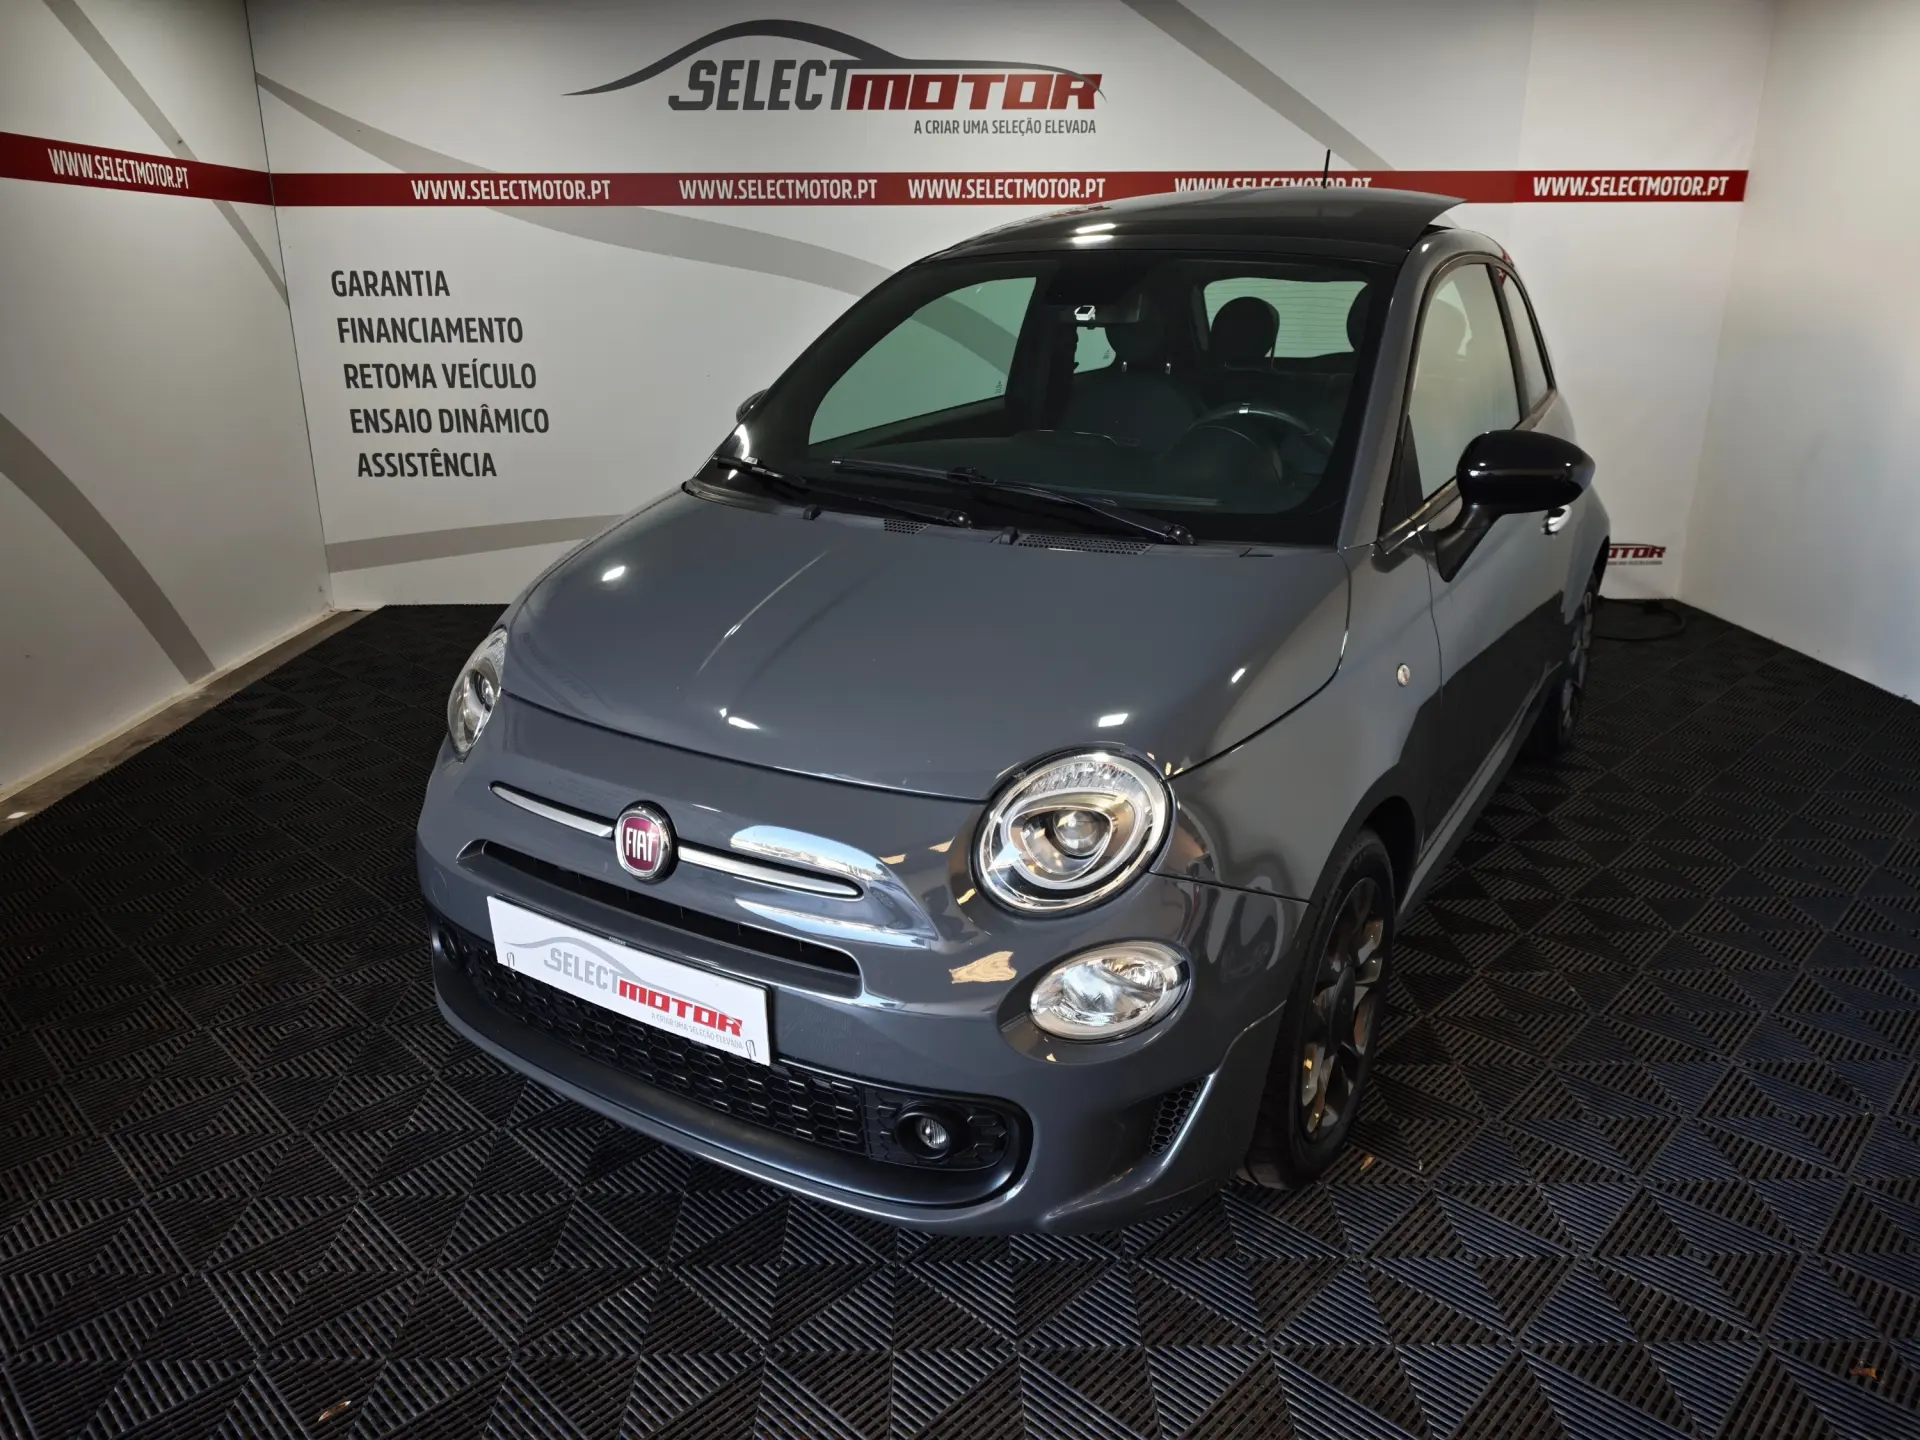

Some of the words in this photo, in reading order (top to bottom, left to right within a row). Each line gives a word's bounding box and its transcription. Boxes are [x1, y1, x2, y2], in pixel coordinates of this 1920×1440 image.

[914, 120, 922, 134] A
[925, 120, 960, 134] CRIAR
[963, 120, 989, 134] UMA
[992, 117, 1042, 136] SELEÇÃO
[1045, 119, 1096, 134] ELEVADA
[47, 148, 189, 189] WWW.SELECTMOTOR.PT
[411, 180, 611, 200] WWW.SELECTMOTOR.PT
[679, 179, 878, 200] WWW.SELECTMOTOR.PT
[908, 178, 1106, 199] WWW.SELECTMOTOR.PT
[1533, 176, 1730, 196] WWW.SELECTMOTOR.PT
[331, 270, 451, 297] GARANTIA
[337, 317, 524, 343] FINANCIAMENTO
[343, 363, 438, 389] RETOMA
[441, 358, 537, 389] VEÍCULO
[349, 408, 432, 433] ENSAIO
[438, 403, 550, 433] DINÂMICO
[357, 447, 497, 477] ASSISTÊNCIA
[625, 826, 657, 863] FIAT
